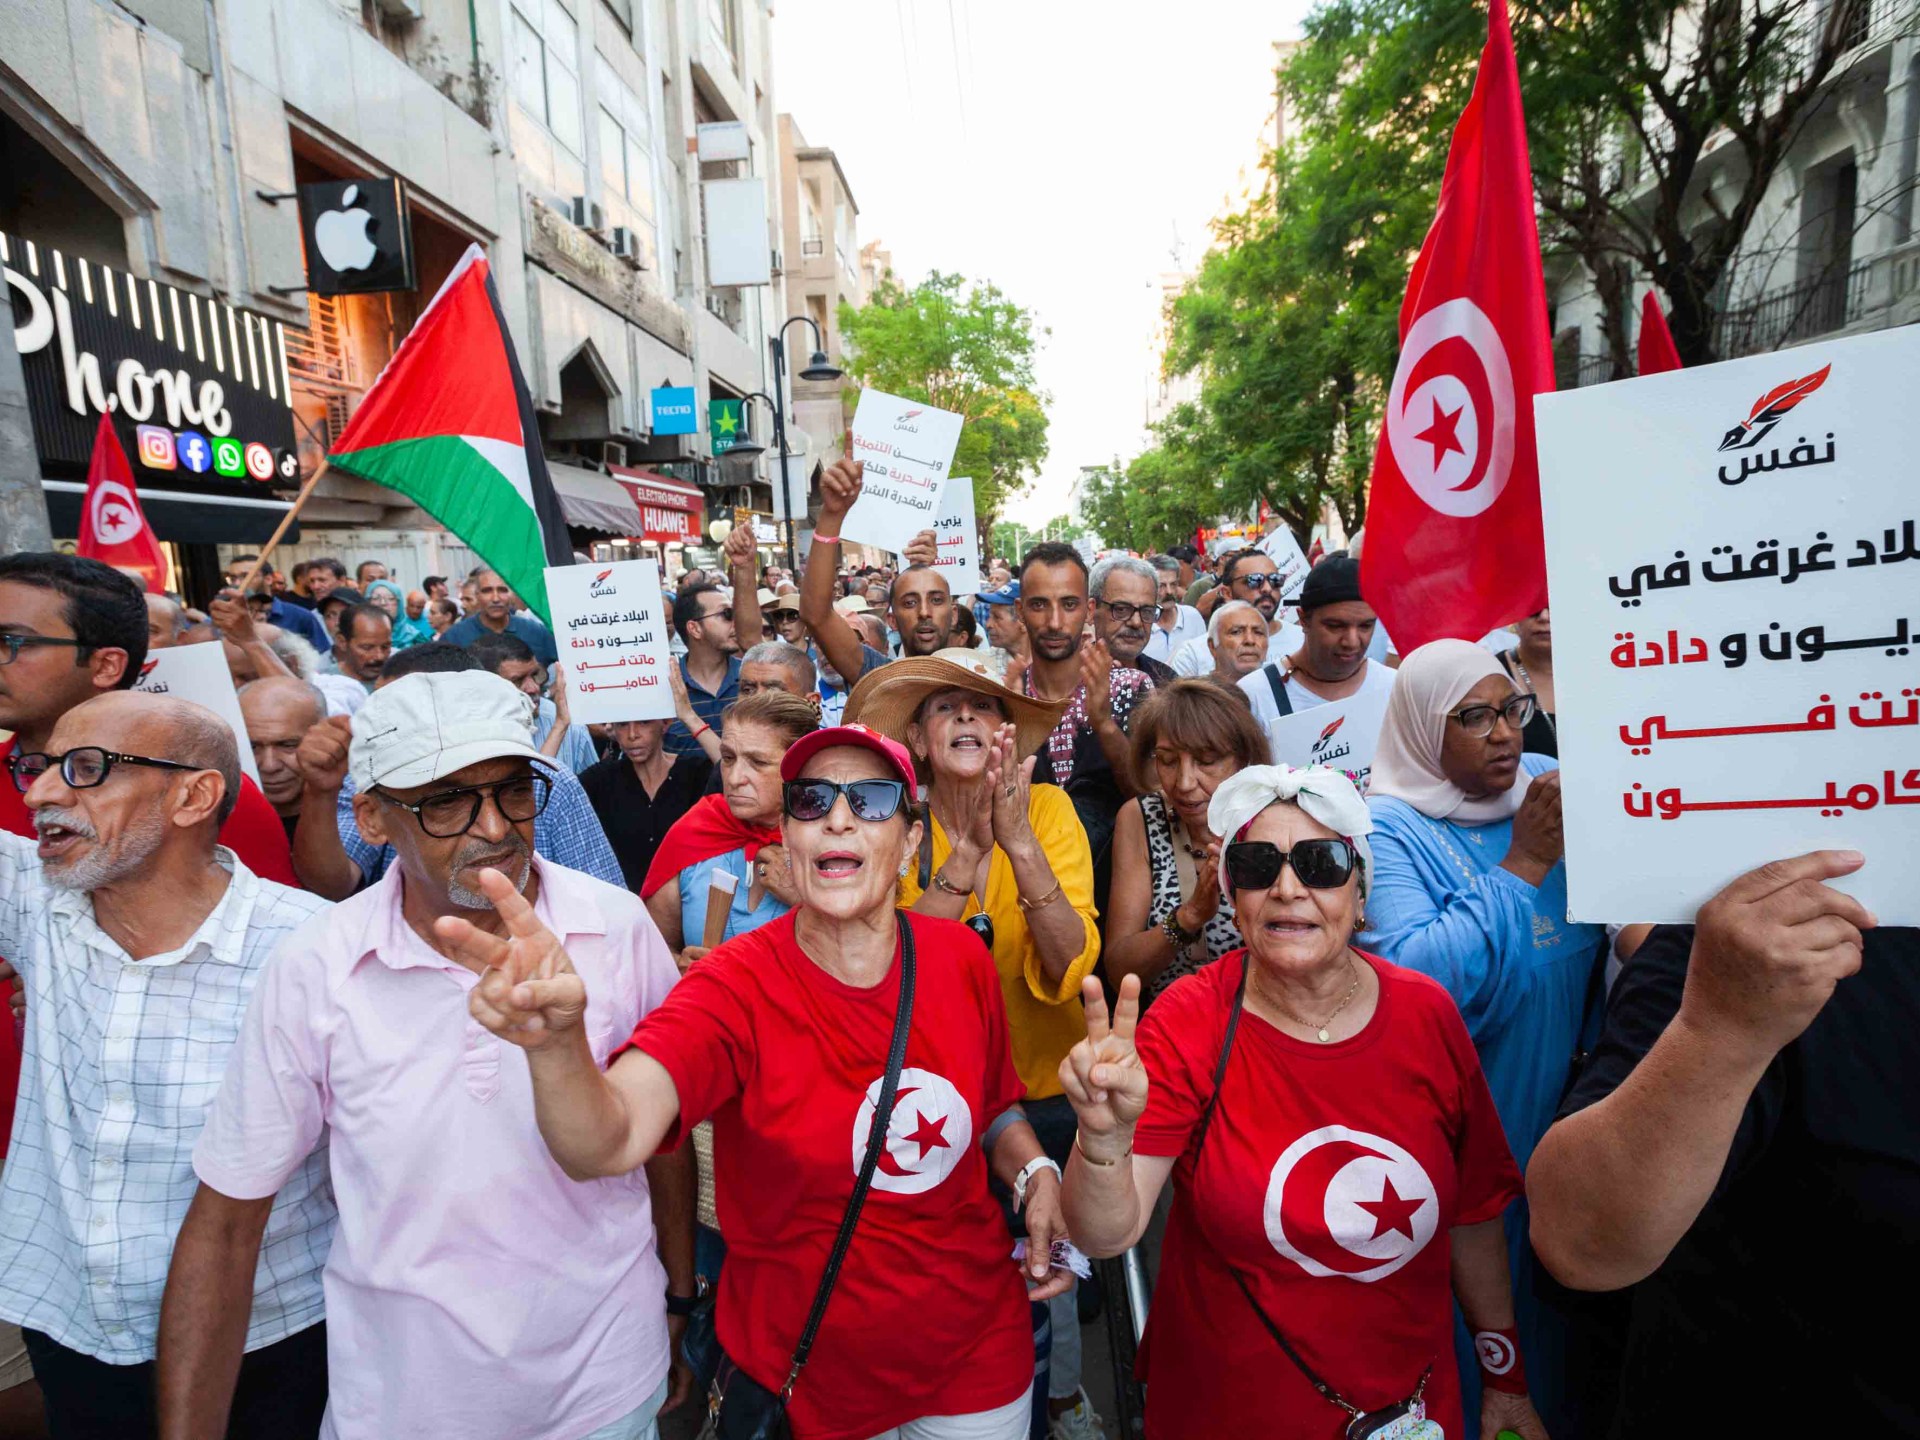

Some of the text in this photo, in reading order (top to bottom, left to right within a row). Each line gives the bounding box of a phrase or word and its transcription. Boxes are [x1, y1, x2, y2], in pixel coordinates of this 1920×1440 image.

[893, 423, 918, 433] نفس
[716, 440, 734, 449] STA
[854, 434, 943, 471] وين التنمية
[1718, 431, 1836, 486] نفس
[637, 487, 688, 507] ELECTRO PHONE
[862, 484, 932, 511] المقدرة الشر
[644, 507, 689, 535] HUAWEI
[1608, 519, 1920, 608] لاد غرقت في
[590, 586, 617, 598] نفس
[568, 610, 649, 631] البلاد غرقت في
[571, 632, 653, 648] الديون و دادة
[1610, 618, 1920, 669] يون و دادة
[576, 656, 626, 673] في
[580, 675, 658, 692] الكاميون
[1619, 694, 1836, 757] في
